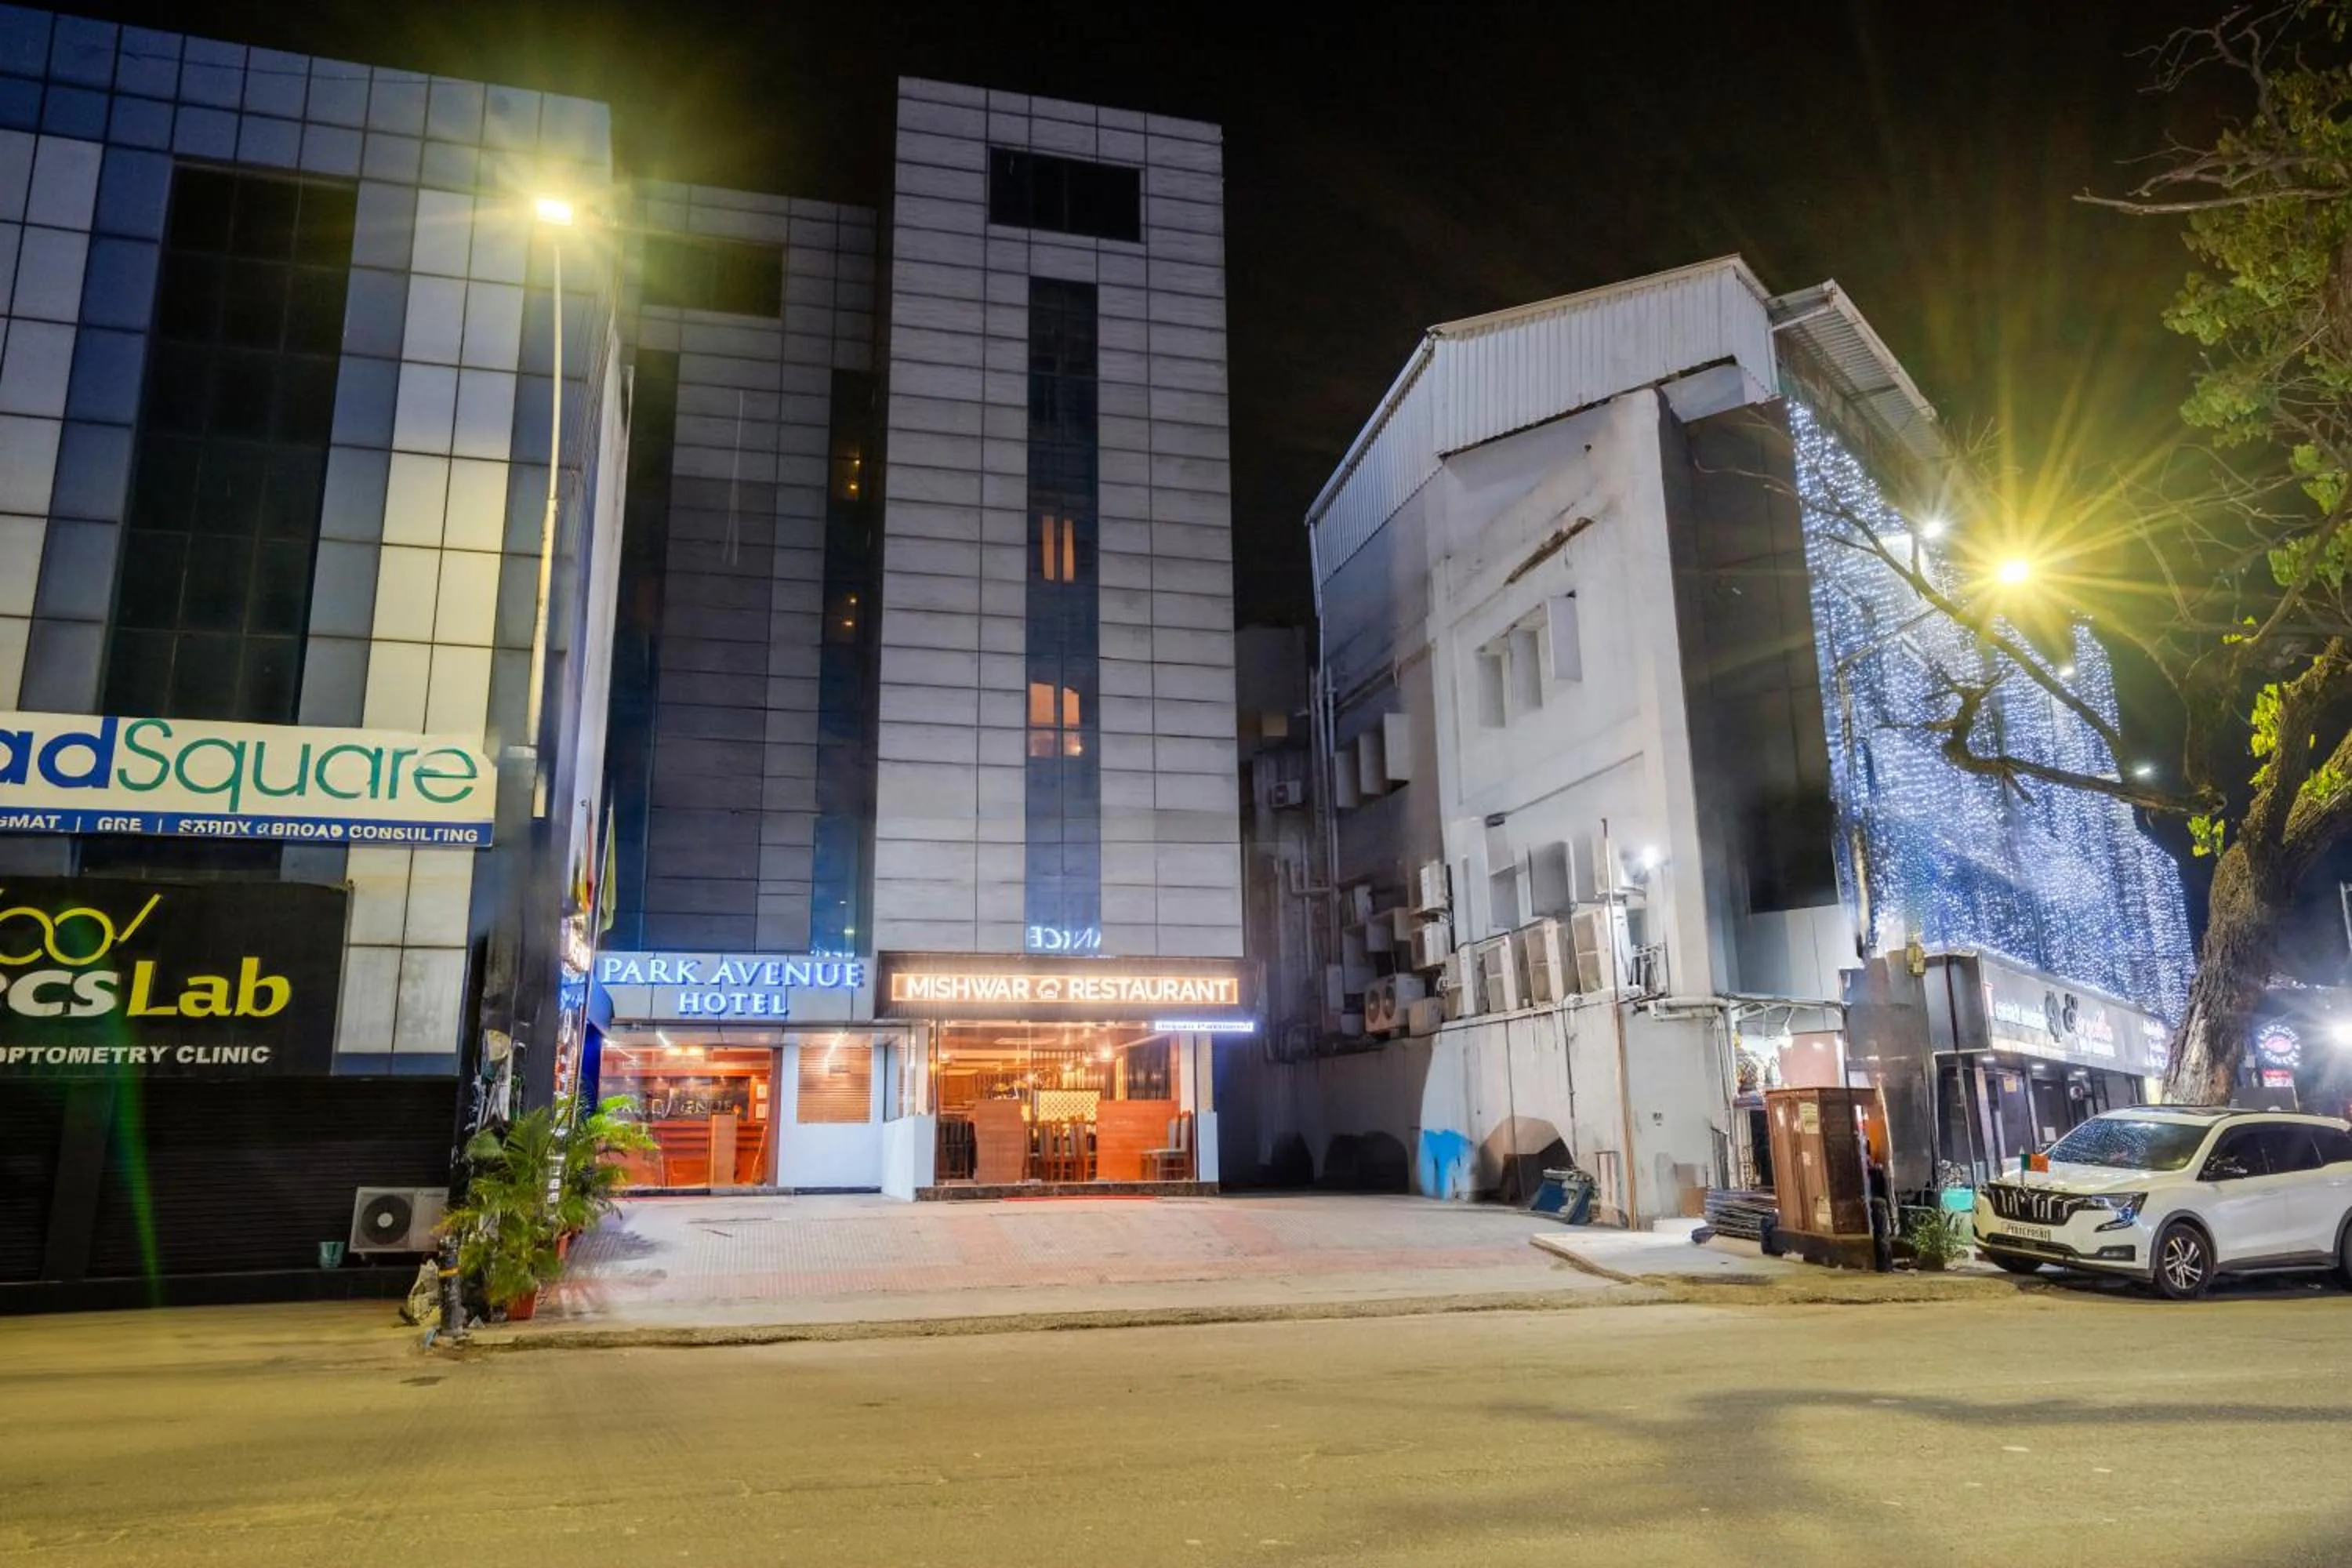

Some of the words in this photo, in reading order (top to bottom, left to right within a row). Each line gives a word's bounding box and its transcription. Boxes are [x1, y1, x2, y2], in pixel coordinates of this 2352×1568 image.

[97, 816, 143, 832] GRE
[349, 825, 478, 843] CONSULTING
[602, 957, 702, 985] PARK
[708, 960, 865, 988] AVENUE
[906, 977, 1029, 1000] MISHWAR
[1068, 978, 1230, 1002] RESTAURANT
[678, 991, 789, 1015] HOTEL
[176, 1045, 272, 1065] CLINIC
